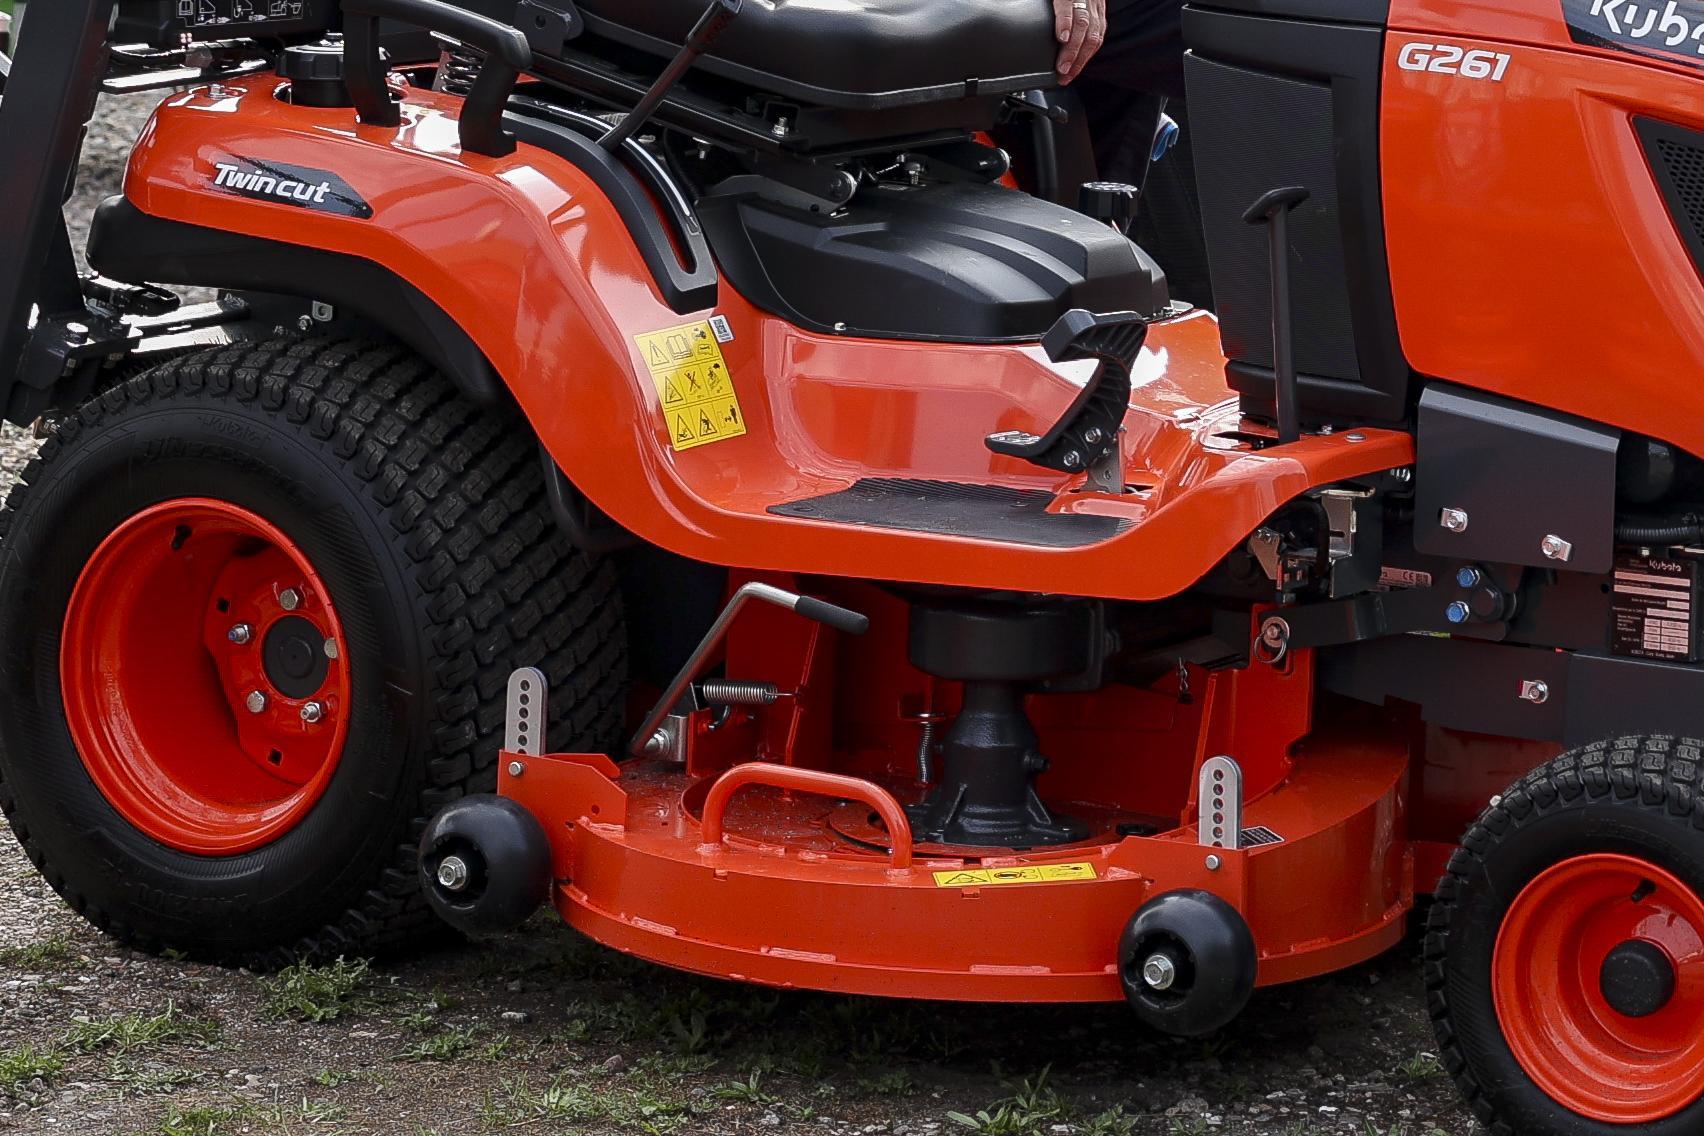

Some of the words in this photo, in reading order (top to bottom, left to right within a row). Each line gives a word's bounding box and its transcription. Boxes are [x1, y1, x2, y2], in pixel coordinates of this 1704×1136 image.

[1398, 42, 1511, 81] G261
[213, 162, 331, 203] Twincut
[1649, 559, 1682, 572] Kubota
